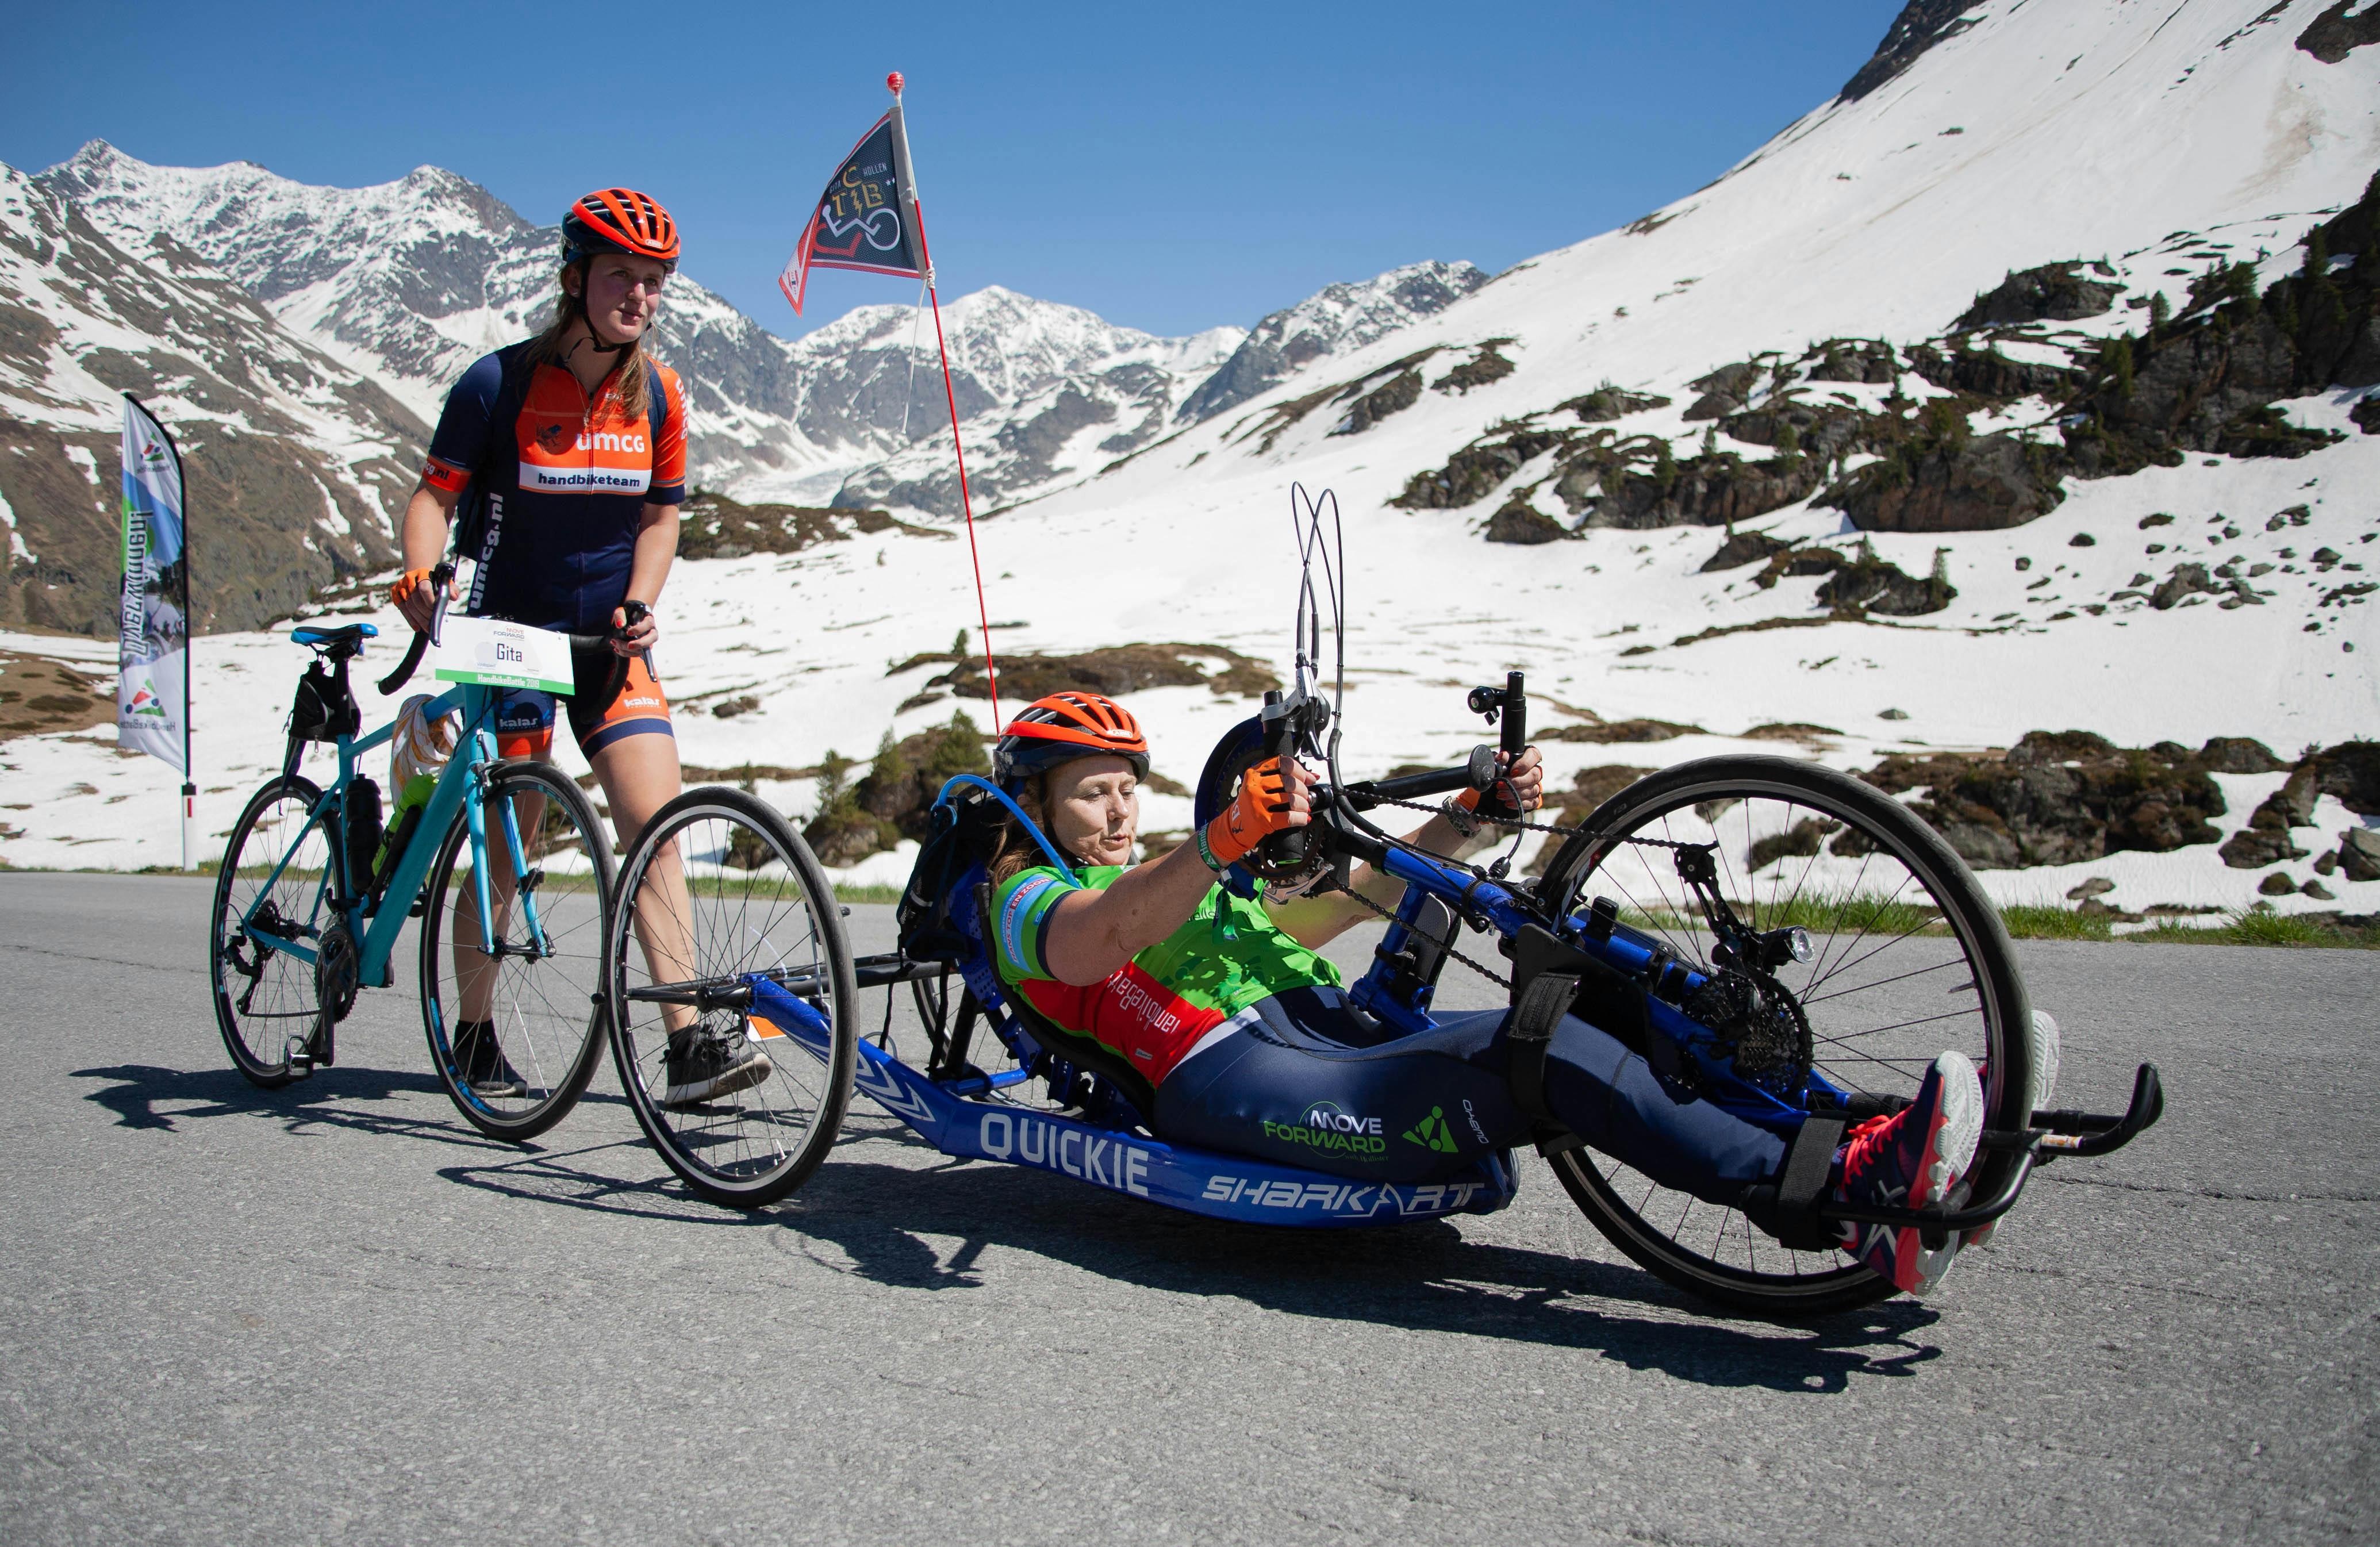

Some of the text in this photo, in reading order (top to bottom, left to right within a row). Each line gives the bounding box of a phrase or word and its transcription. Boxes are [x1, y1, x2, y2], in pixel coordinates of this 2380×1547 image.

[538, 473, 640, 487] handbiketeam
[470, 493, 503, 609] umcg.nl
[497, 643, 522, 662] Gita
[499, 717, 538, 727] kalas
[1012, 895, 1022, 907] EN
[1021, 878, 1051, 894] ZOON
[1310, 1110, 1383, 1135] MOVE
[1264, 1120, 1386, 1153] FORWARD
[980, 1112, 1150, 1197] QUICKIE
